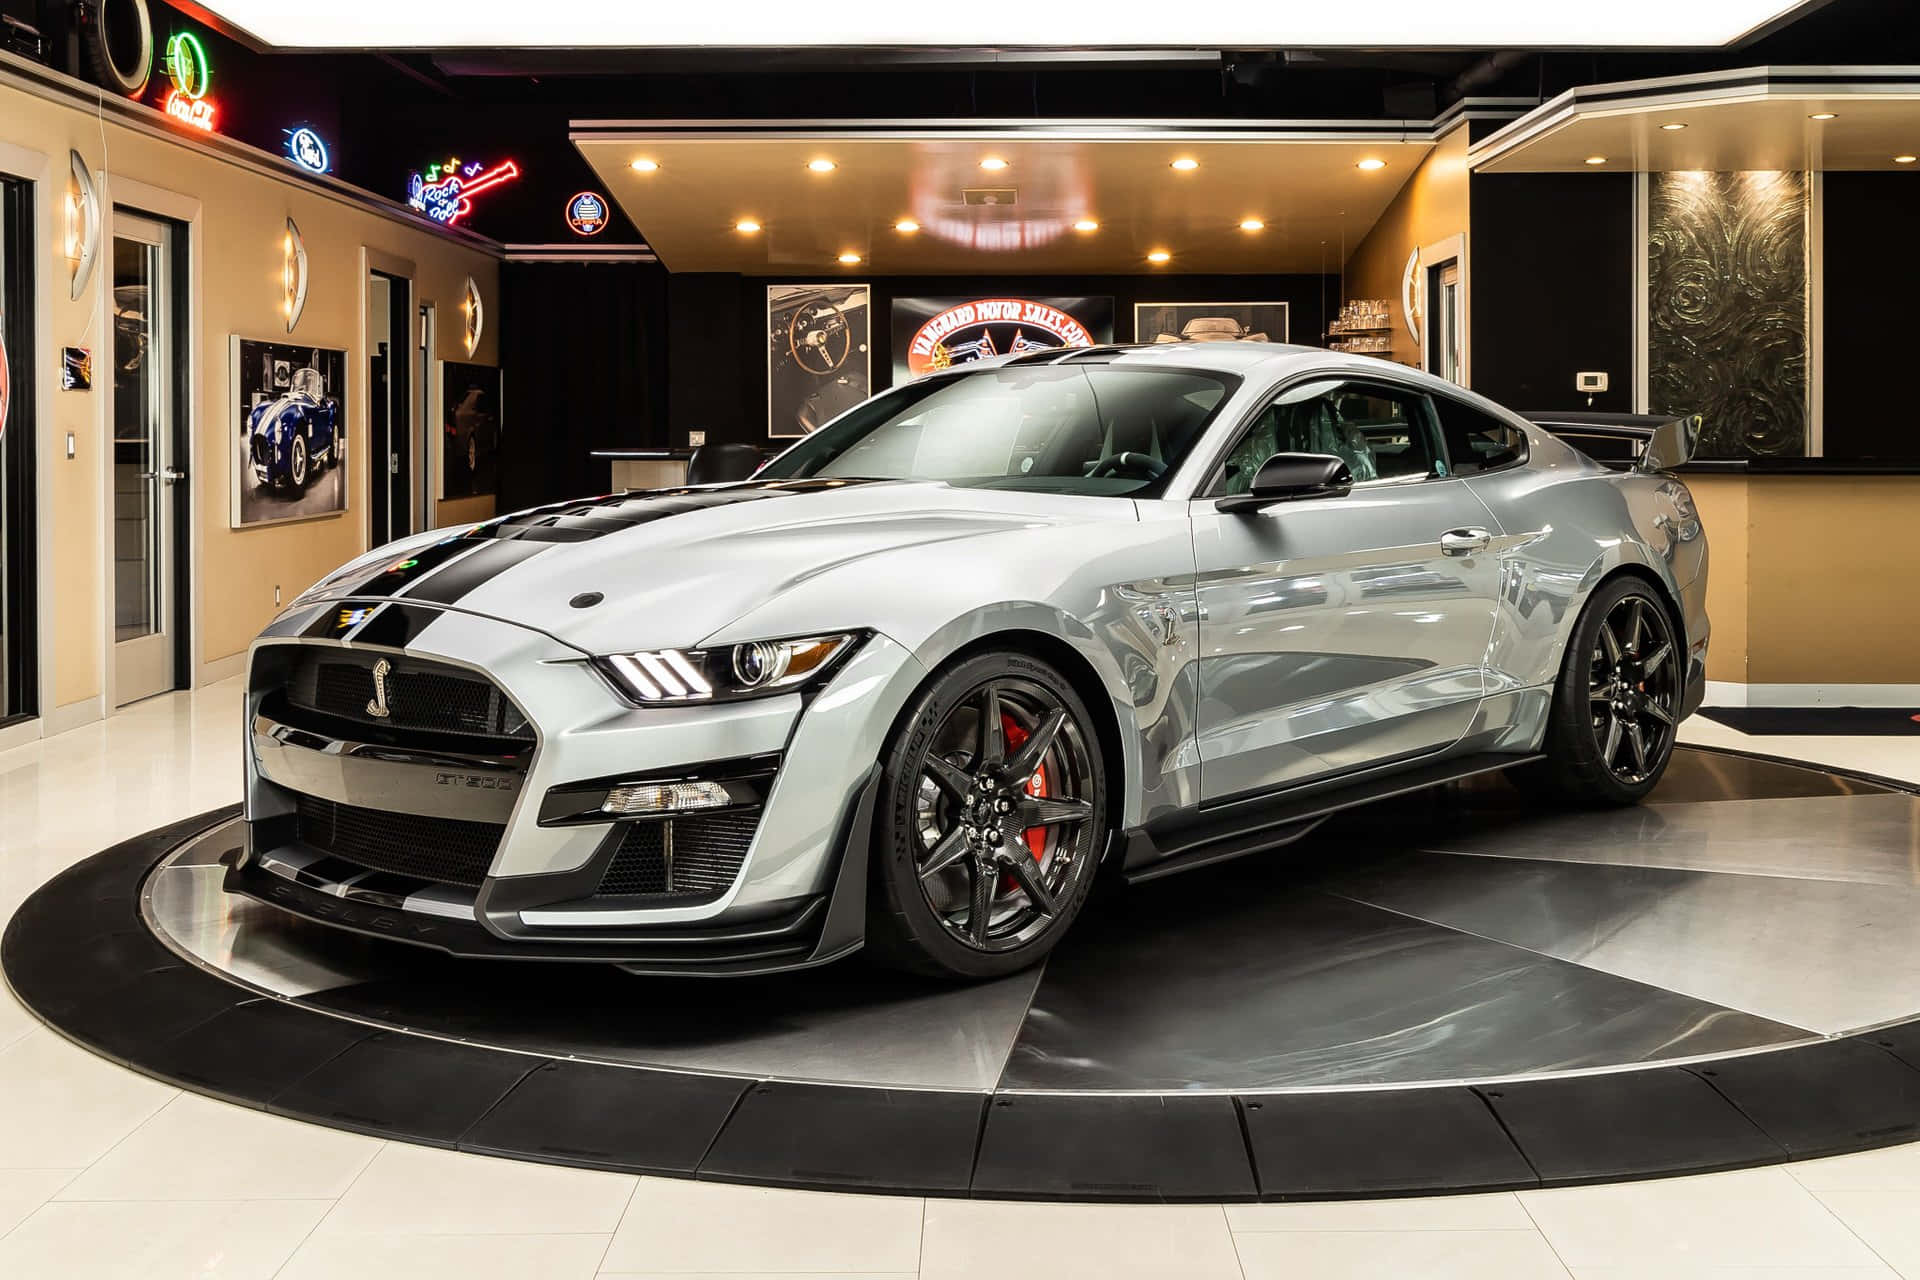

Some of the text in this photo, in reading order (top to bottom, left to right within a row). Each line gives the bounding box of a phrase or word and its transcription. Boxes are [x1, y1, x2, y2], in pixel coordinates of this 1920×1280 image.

[423, 178, 459, 206] Rock
[912, 305, 975, 356] VANGUARD
[976, 301, 1021, 321] MOTOR
